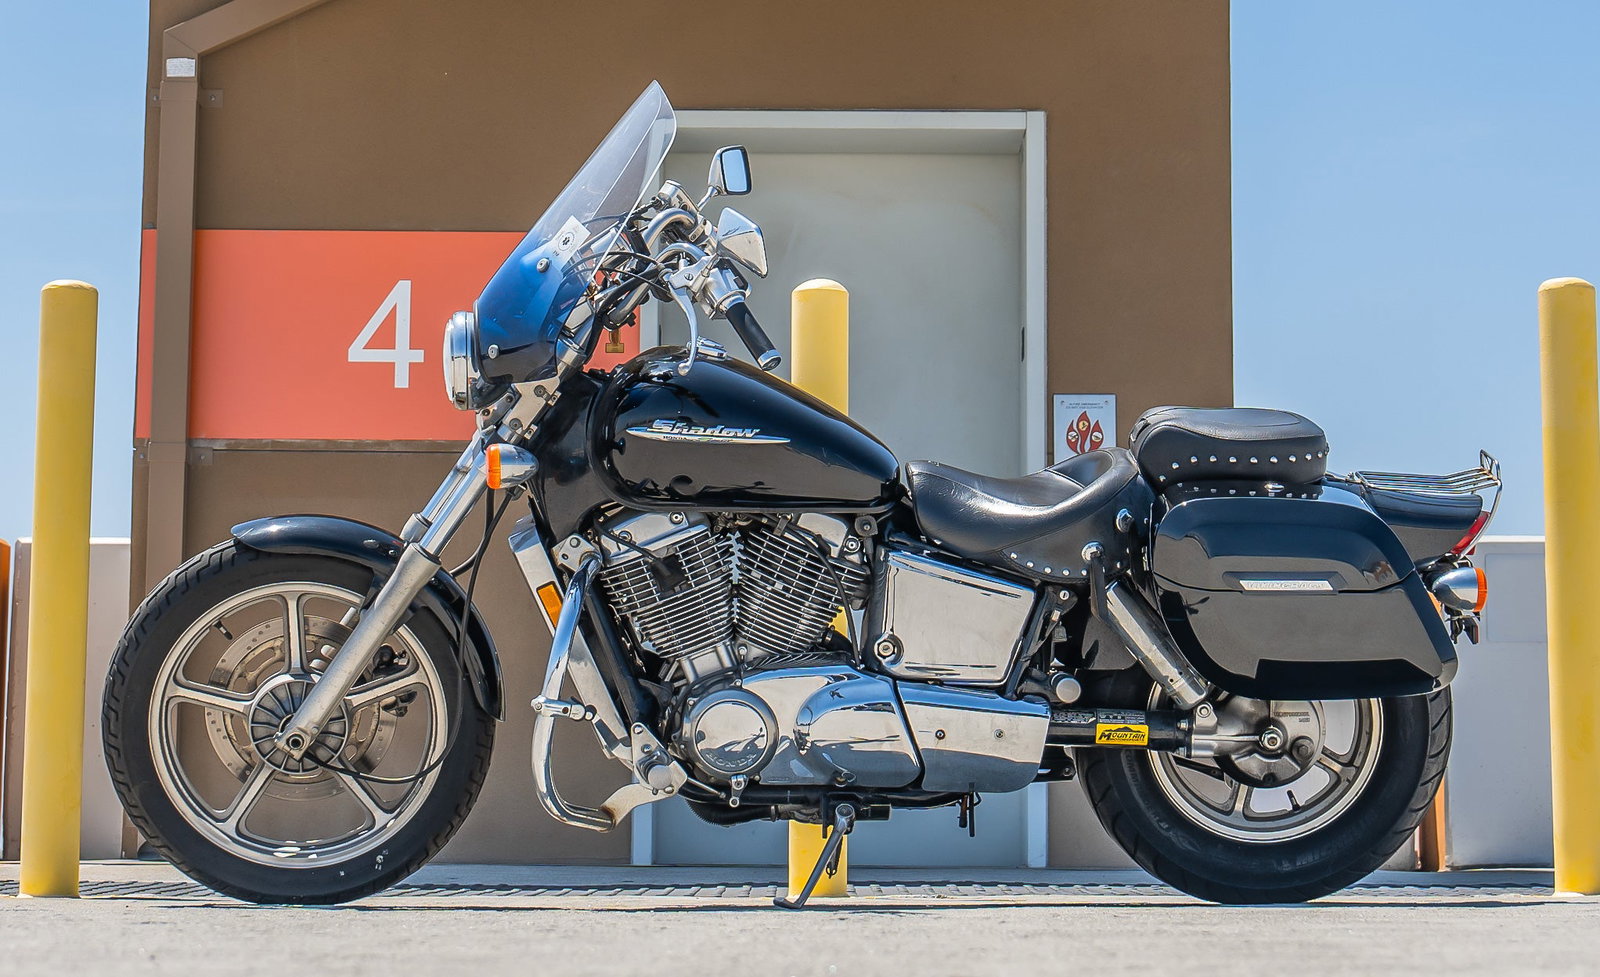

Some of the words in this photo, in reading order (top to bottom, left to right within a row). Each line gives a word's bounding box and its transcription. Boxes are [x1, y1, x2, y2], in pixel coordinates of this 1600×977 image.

[347, 280, 425, 389] 4
[652, 419, 760, 437] Shadow
[1099, 732, 1146, 740] MOUNTAIN
[705, 754, 757, 768] HONDA
